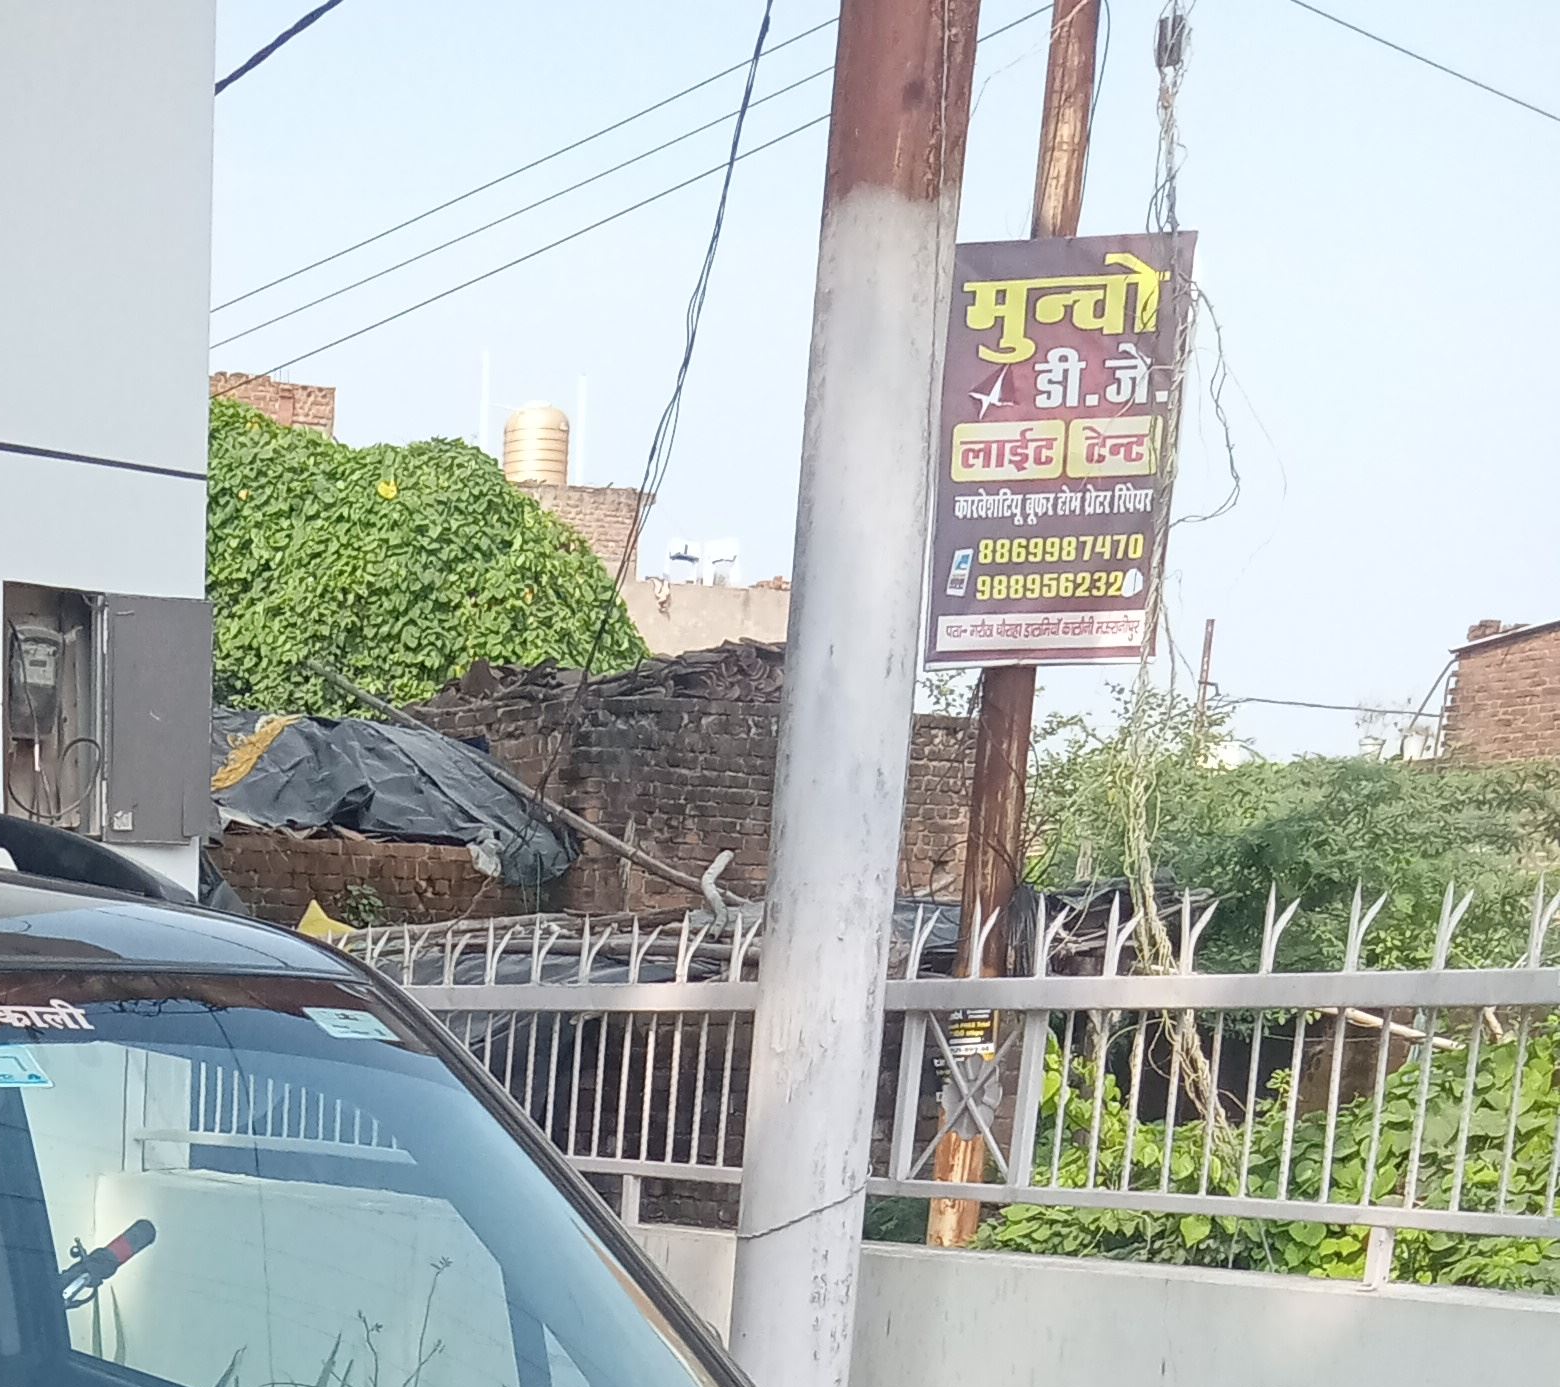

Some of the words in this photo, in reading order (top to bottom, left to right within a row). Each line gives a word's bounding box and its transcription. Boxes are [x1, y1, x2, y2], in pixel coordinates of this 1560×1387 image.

[959, 428, 1058, 472] लाईट
[1082, 425, 1150, 464] टेन्ट
[977, 534, 1144, 564] 8869987470
[976, 571, 1130, 600] 988956232
